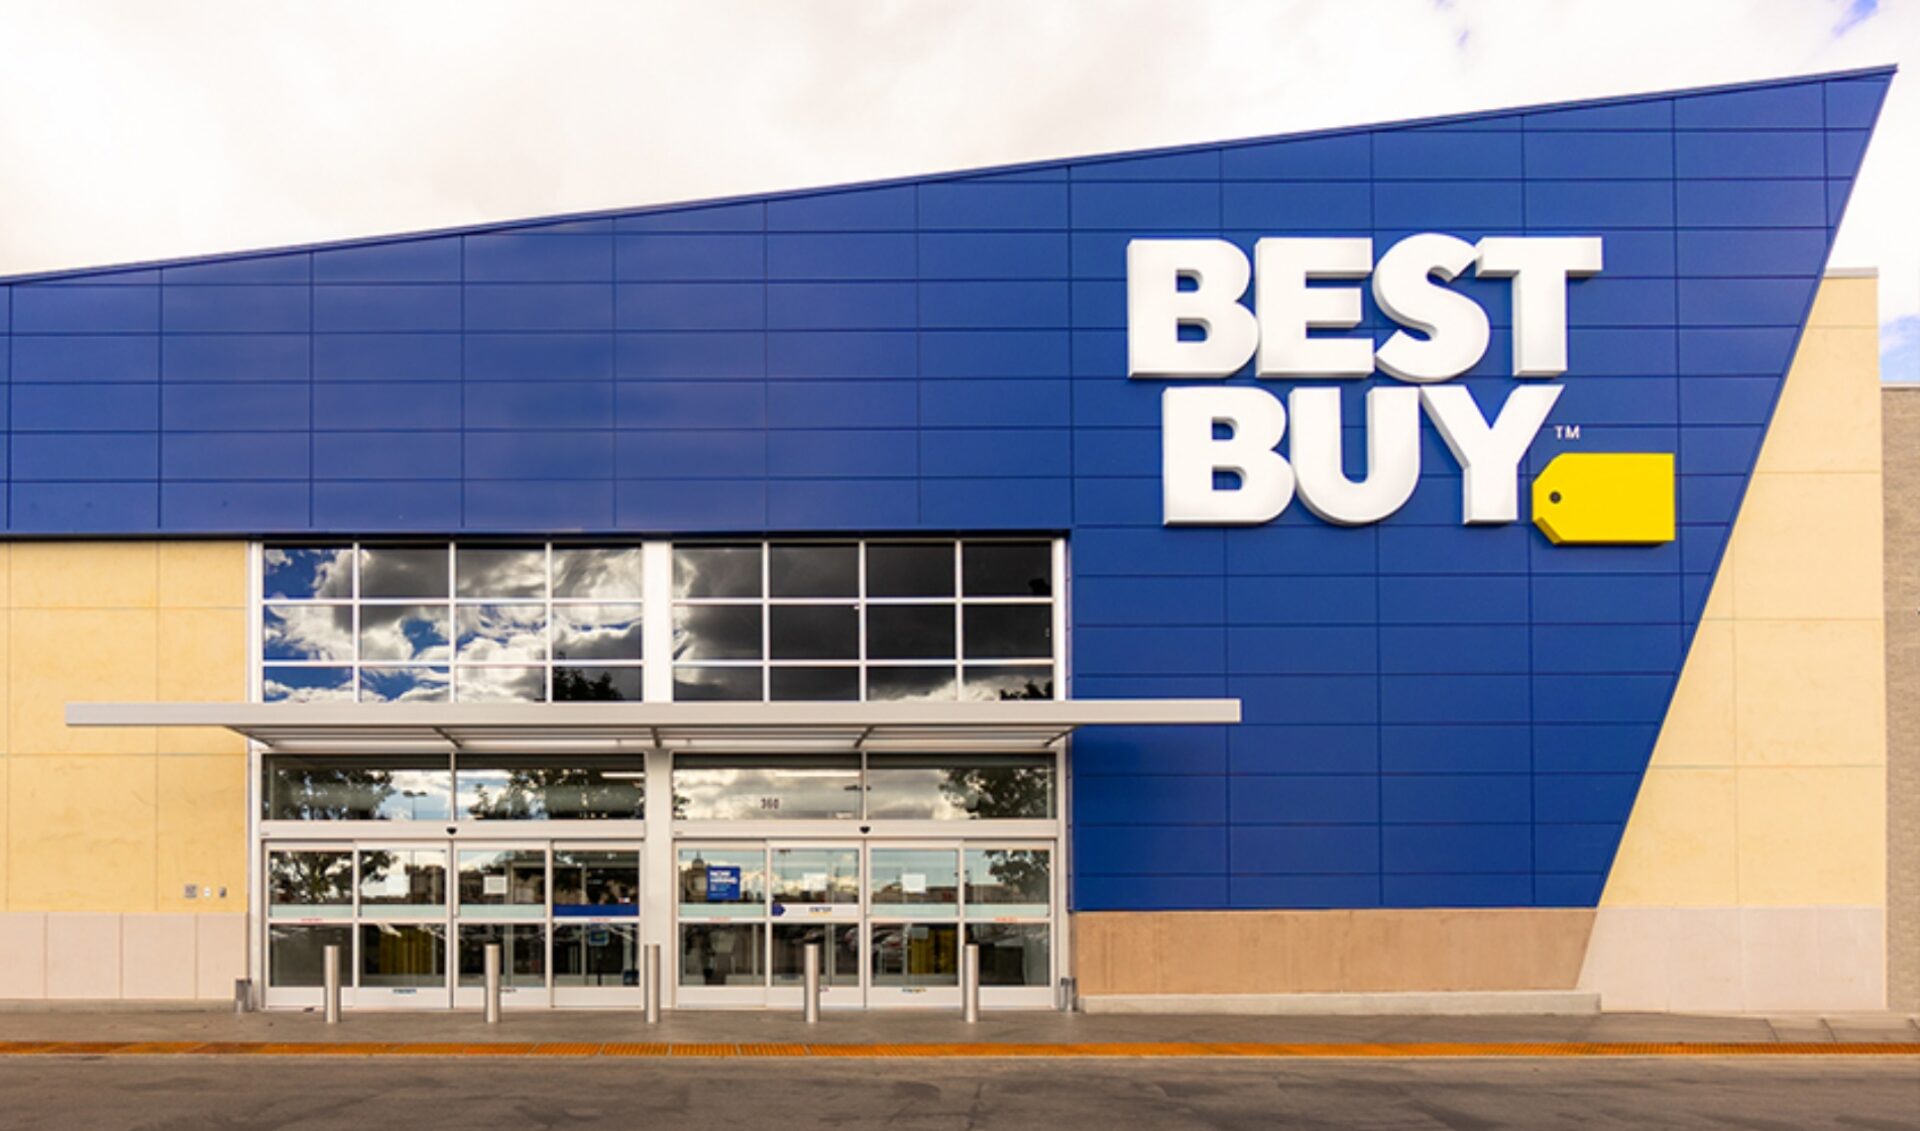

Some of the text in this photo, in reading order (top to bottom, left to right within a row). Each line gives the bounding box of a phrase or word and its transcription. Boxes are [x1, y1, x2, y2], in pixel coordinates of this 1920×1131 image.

[1127, 232, 1603, 383] BEST
[1162, 384, 1565, 526] BUY
[1554, 425, 1580, 439] TM
